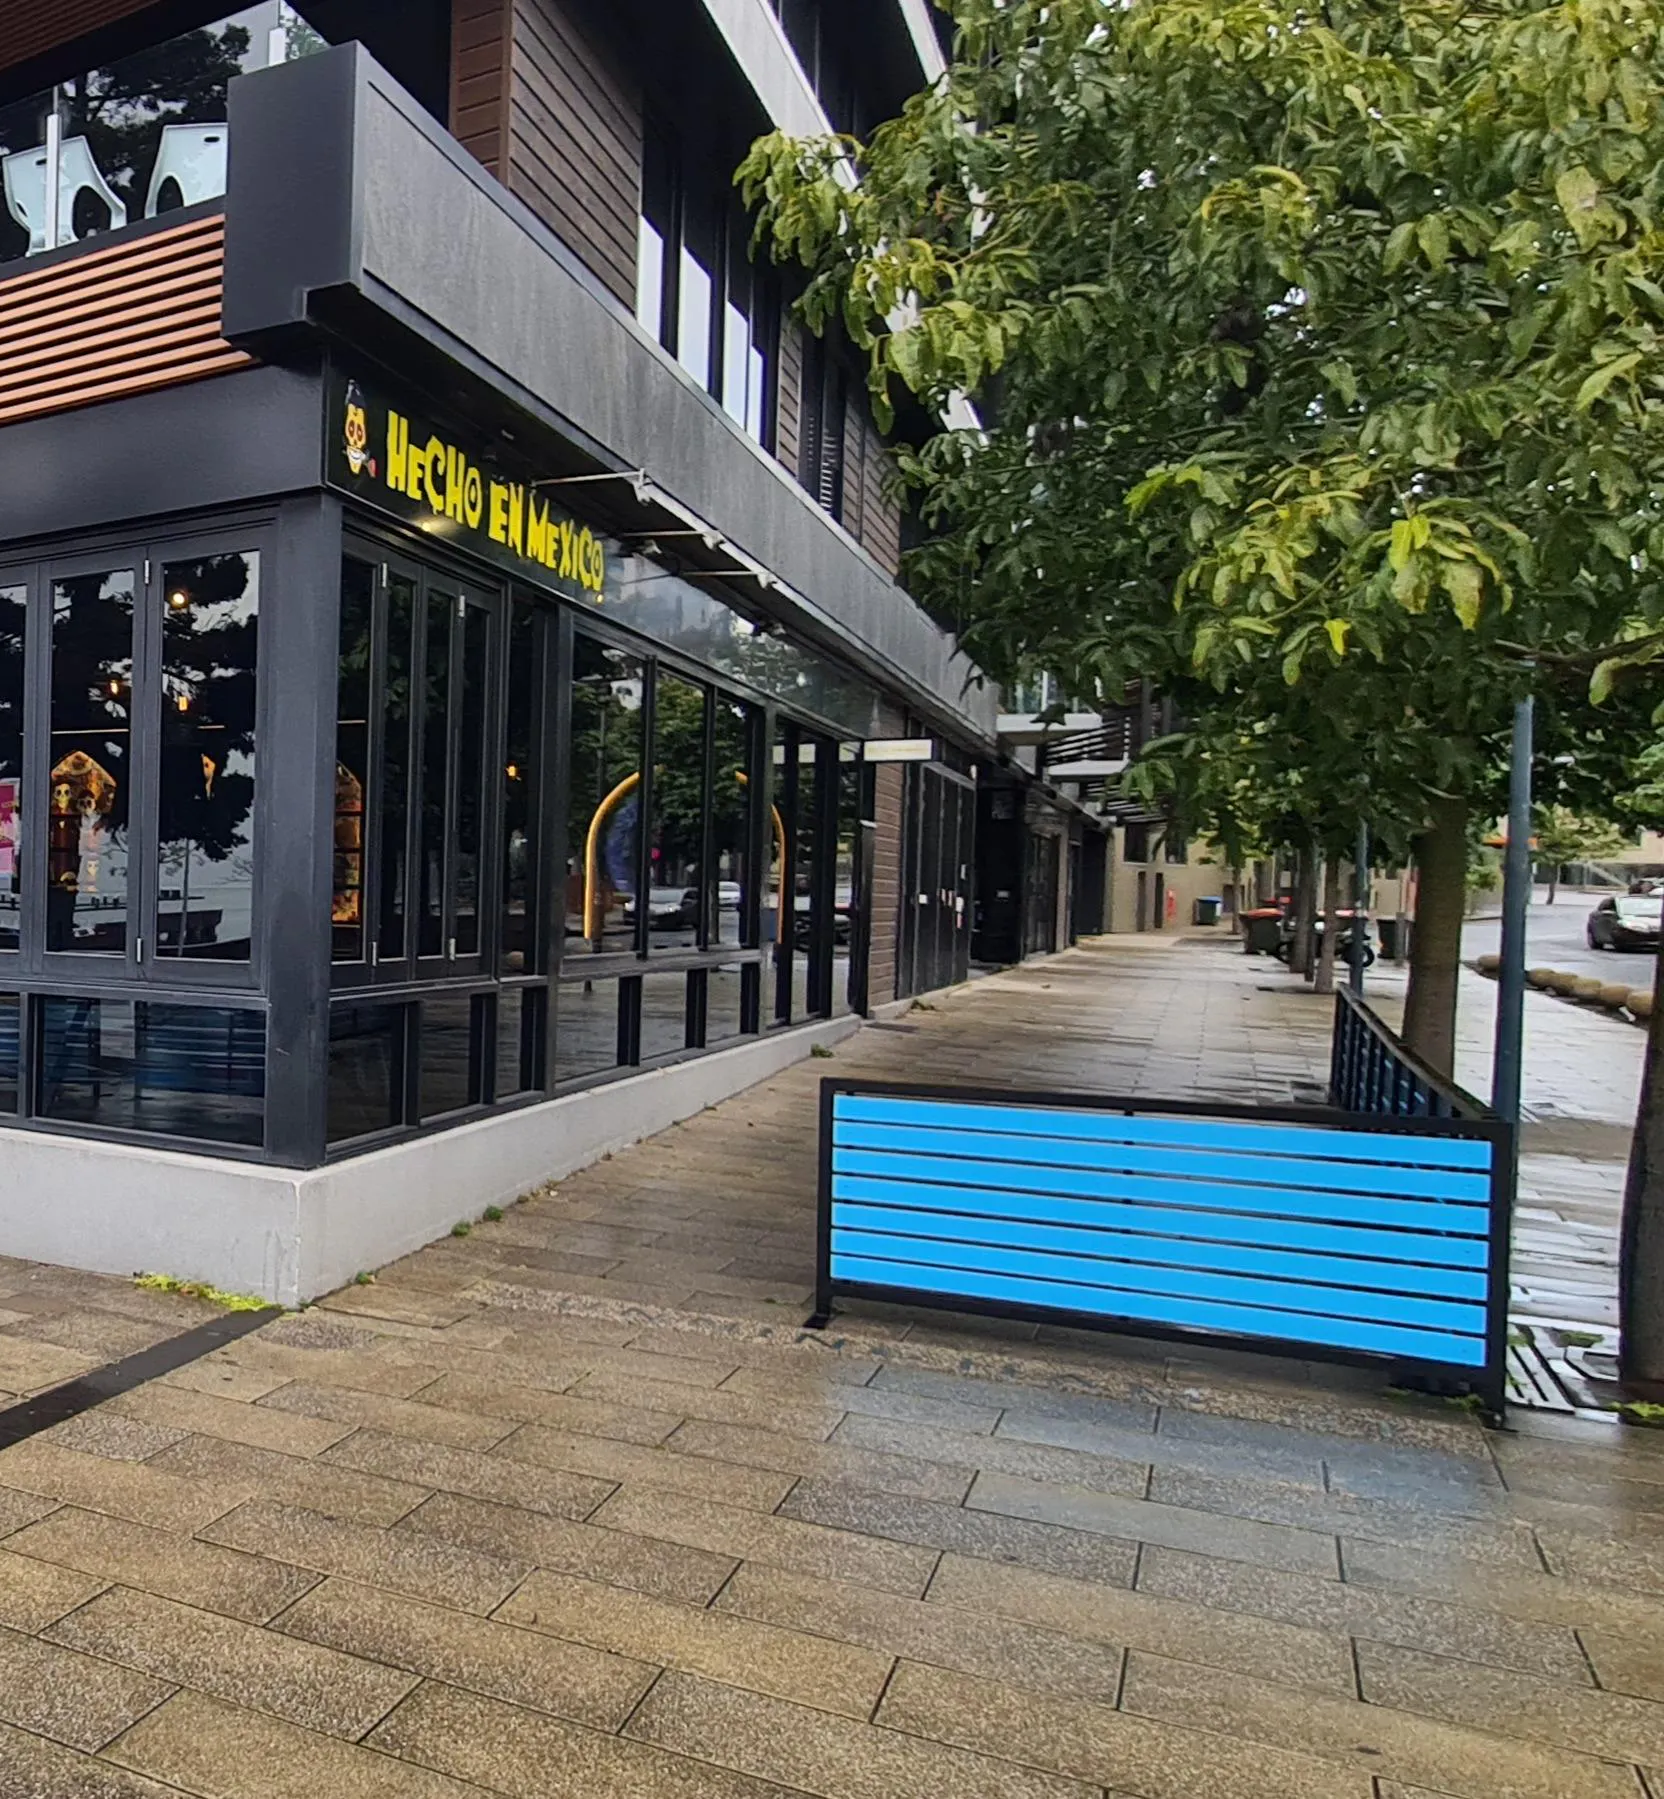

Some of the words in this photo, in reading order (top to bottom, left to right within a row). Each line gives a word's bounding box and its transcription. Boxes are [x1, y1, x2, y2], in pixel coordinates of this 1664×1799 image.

[387, 410, 483, 529] HECHO
[488, 479, 524, 557] EN
[526, 488, 605, 591] MEXICO
